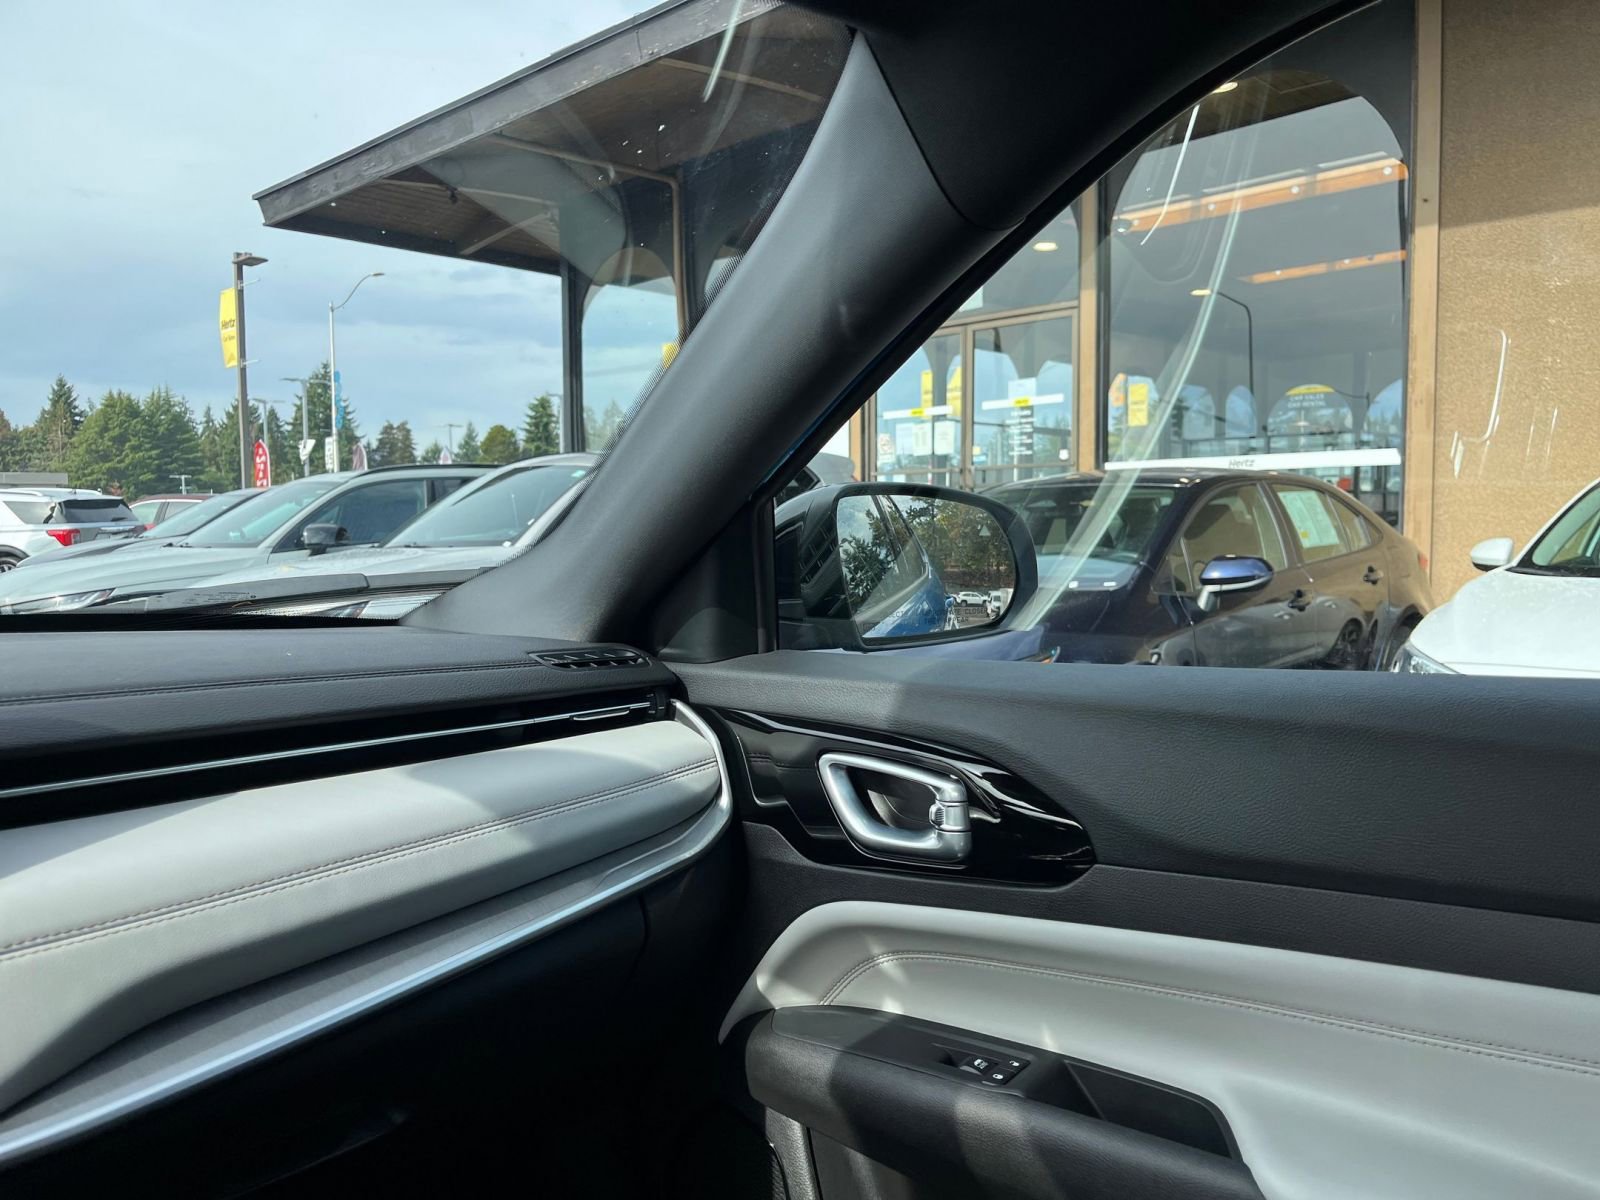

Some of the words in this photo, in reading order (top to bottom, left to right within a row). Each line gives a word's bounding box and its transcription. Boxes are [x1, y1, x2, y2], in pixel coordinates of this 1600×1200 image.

[221, 318, 235, 330] Hertz
[1229, 459, 1255, 469] Hertz
[964, 607, 988, 615] CLOSER
